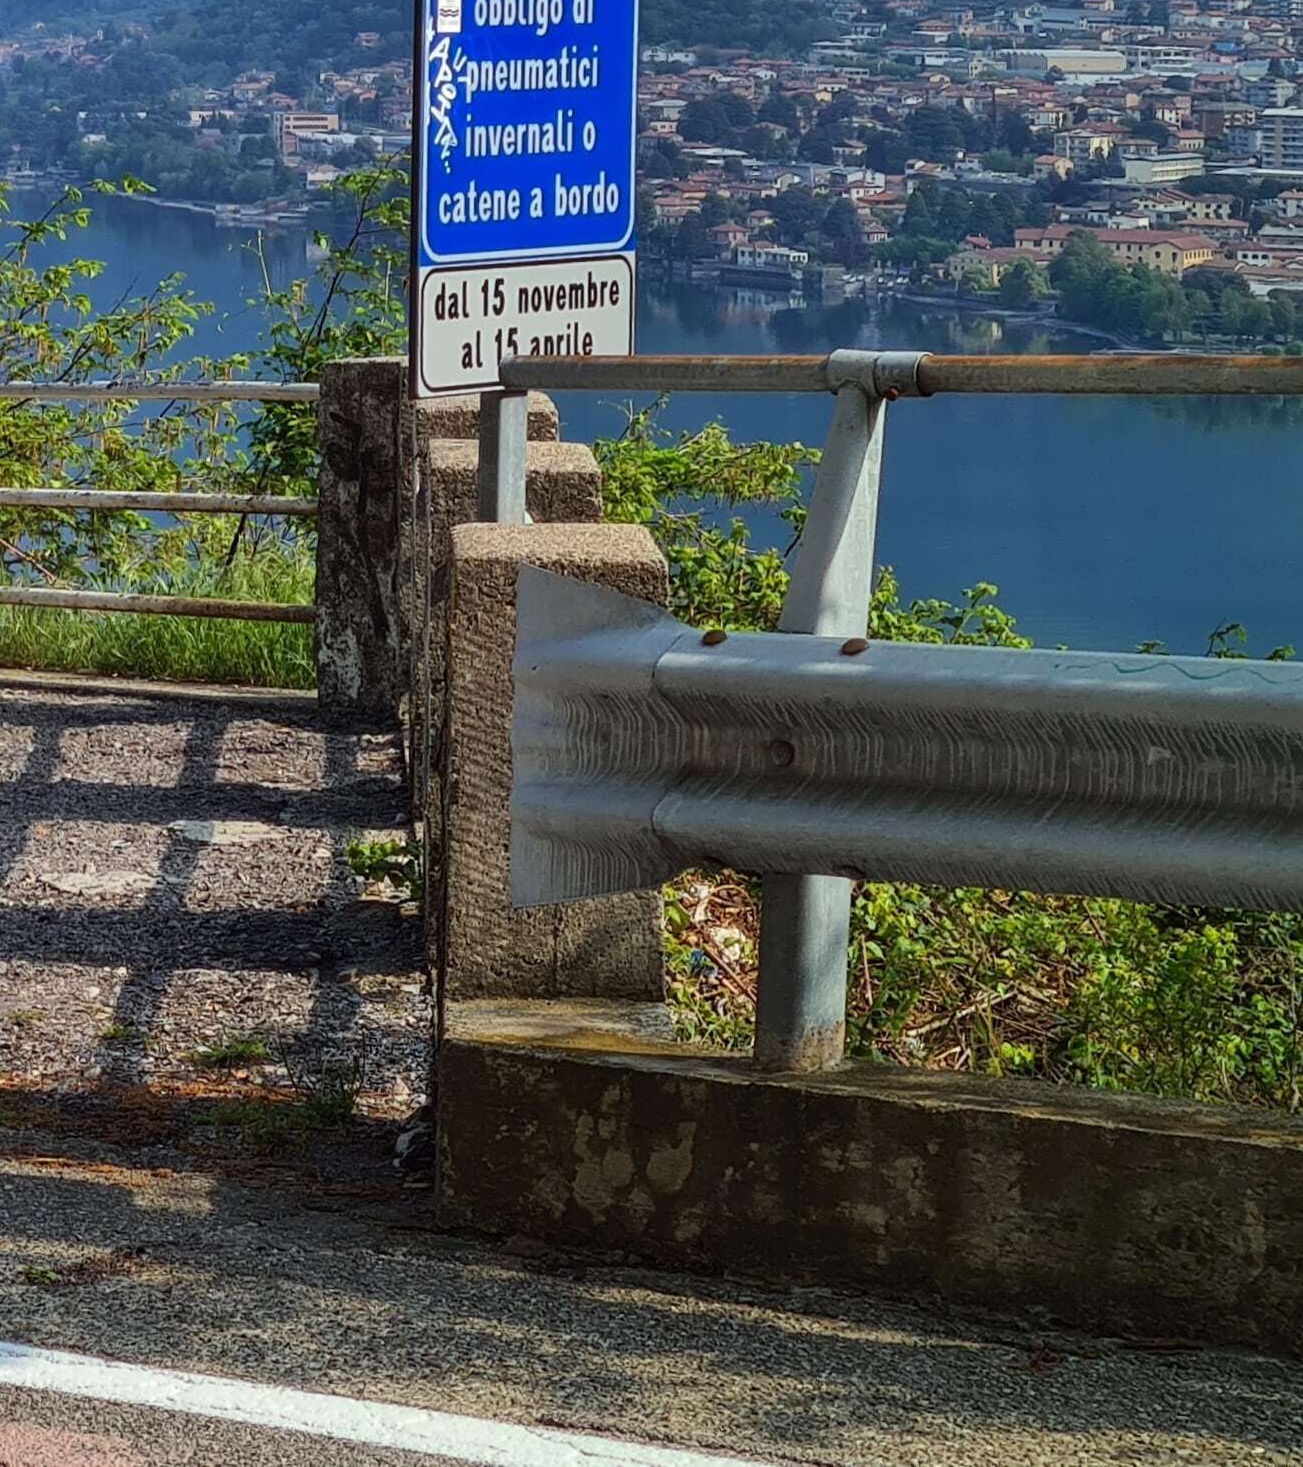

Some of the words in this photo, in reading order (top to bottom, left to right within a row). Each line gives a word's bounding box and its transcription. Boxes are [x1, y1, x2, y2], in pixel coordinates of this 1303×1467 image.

[466, 44, 599, 104] pneumatici
[464, 108, 574, 158] invernali
[582, 120, 595, 151] o
[438, 179, 521, 225] catene
[529, 187, 543, 219] a
[555, 171, 619, 217] bordo
[434, 281, 470, 321] dal
[481, 278, 505, 317] 15
[517, 271, 620, 314] novembre
[461, 330, 483, 370] al
[494, 327, 519, 366] 15
